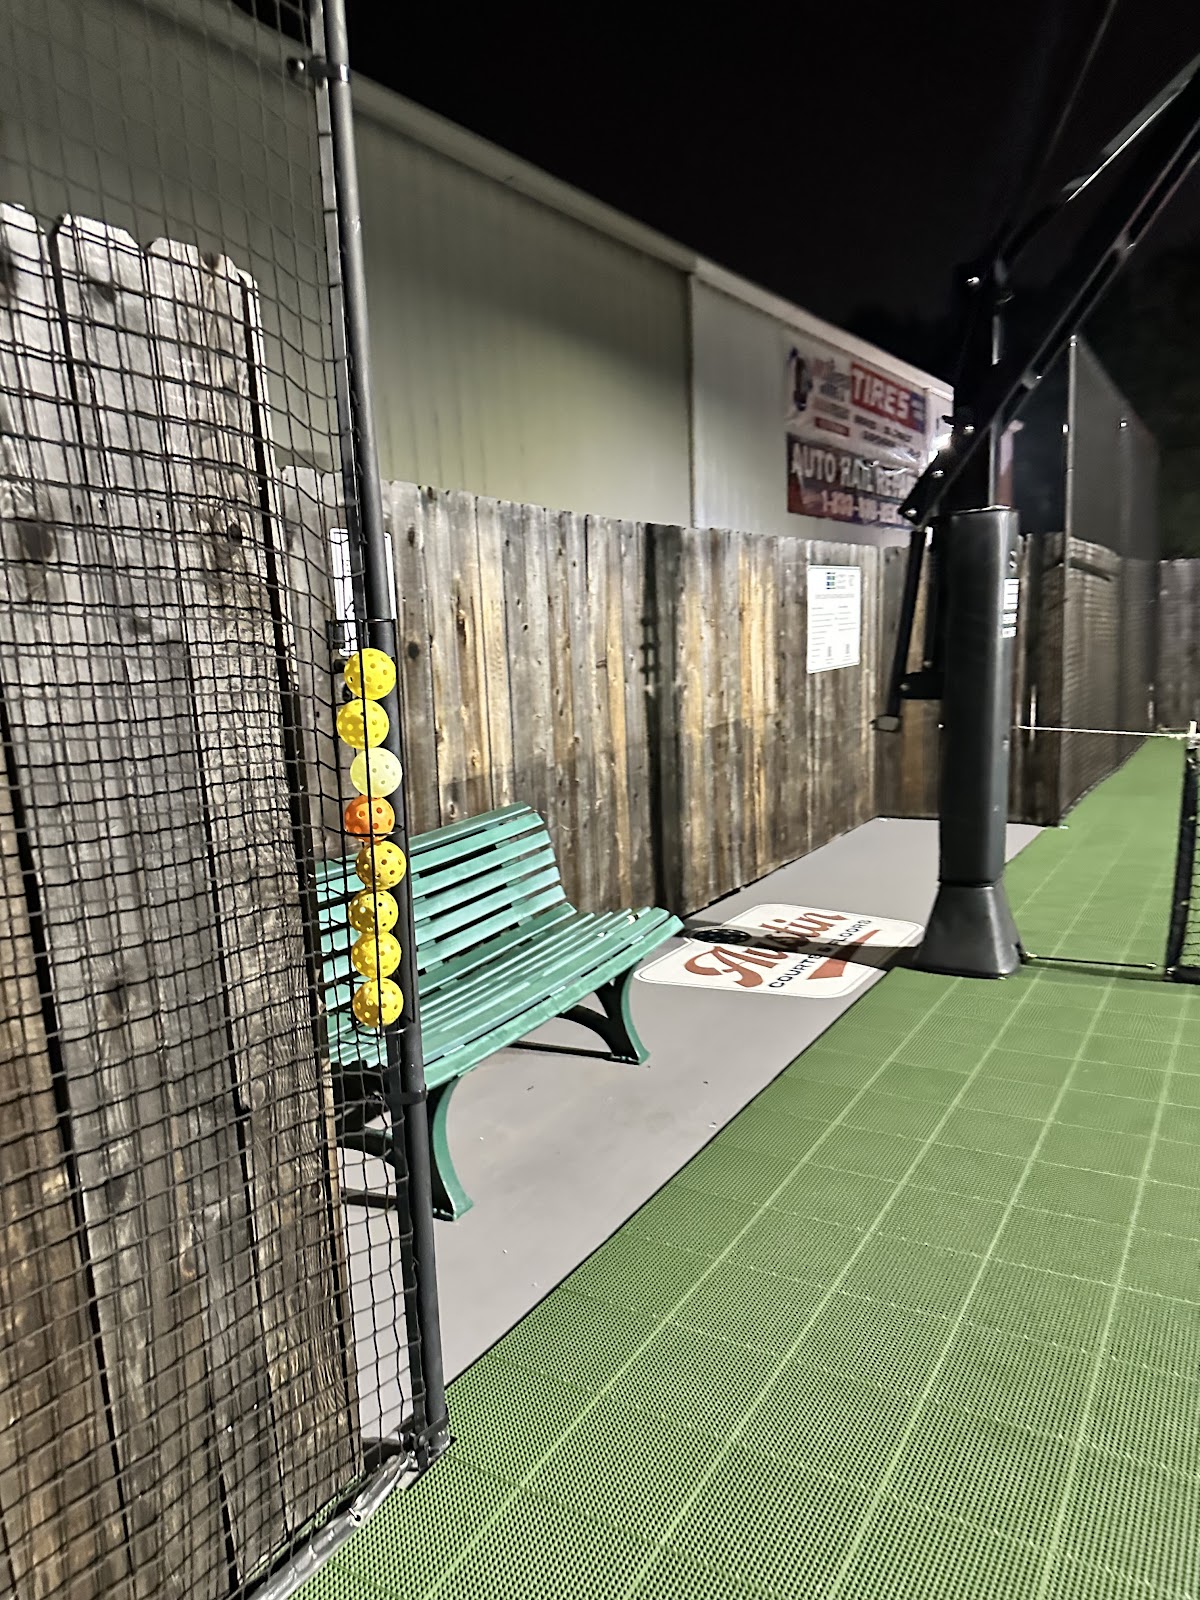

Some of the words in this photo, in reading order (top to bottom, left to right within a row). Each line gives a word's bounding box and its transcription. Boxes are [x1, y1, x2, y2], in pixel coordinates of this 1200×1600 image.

[853, 369, 911, 420] TIRES
[791, 443, 836, 483] AUTO
[684, 911, 848, 988] Austin
[828, 919, 872, 945] FLOORS
